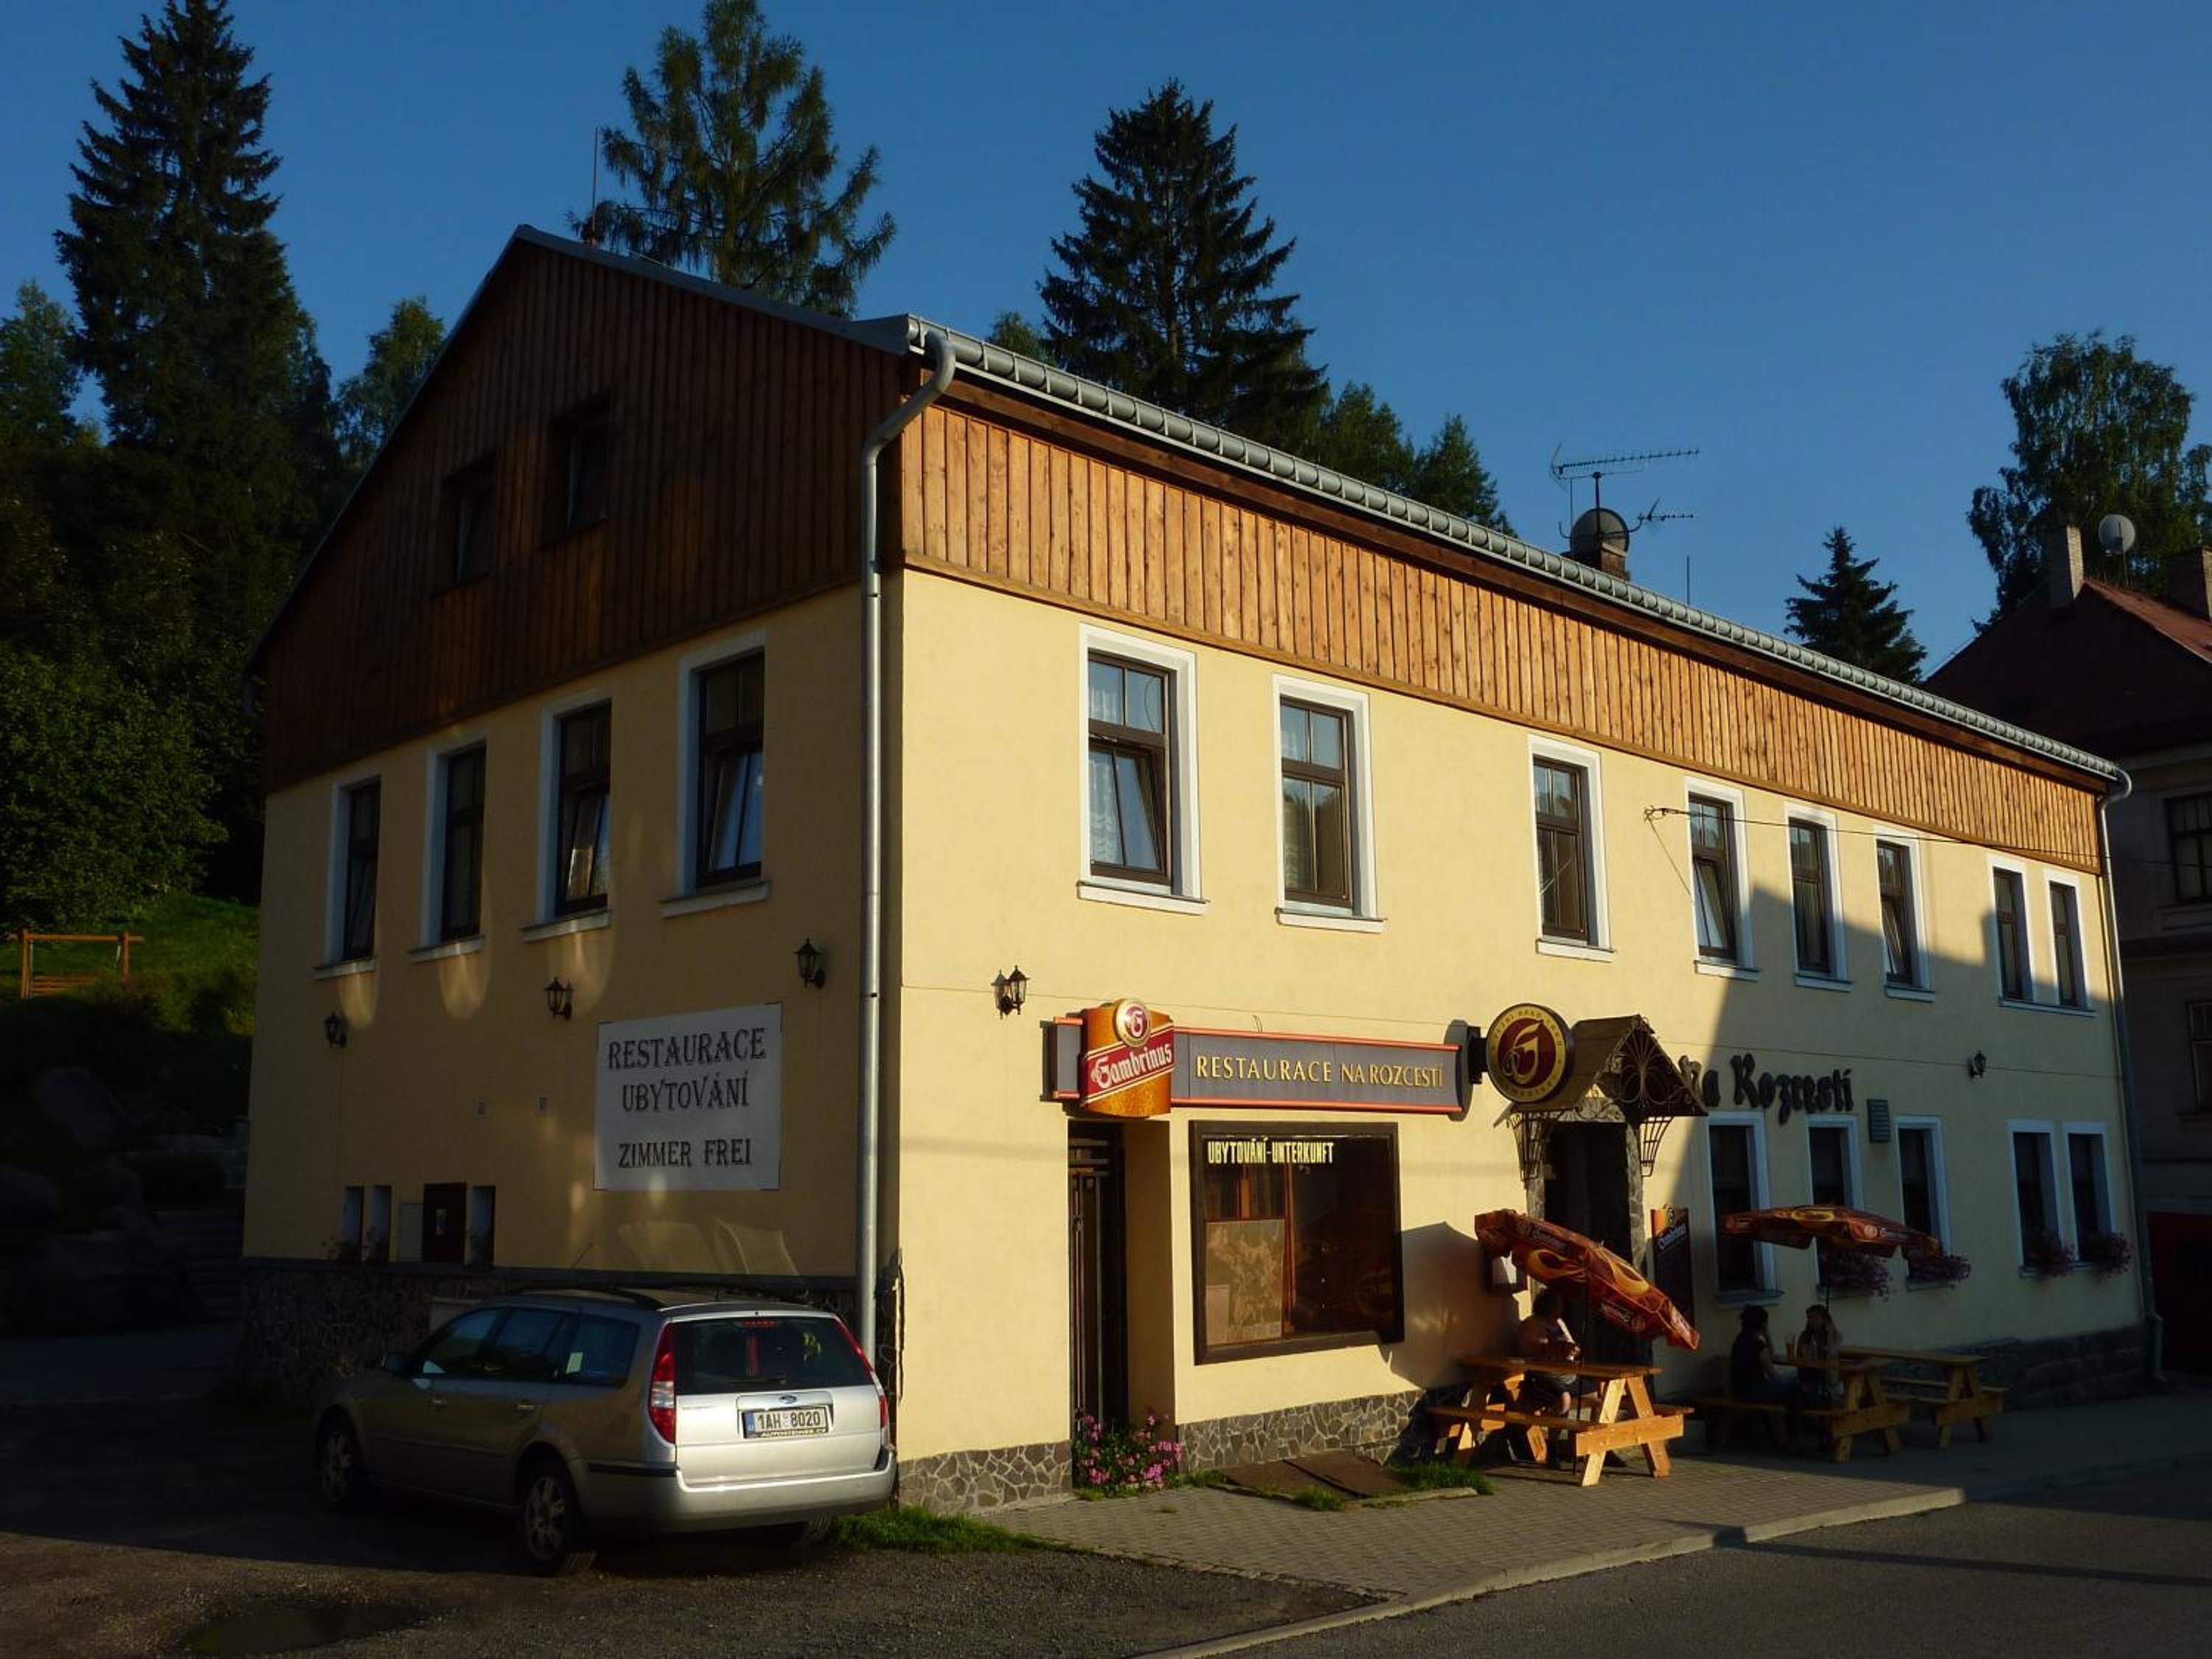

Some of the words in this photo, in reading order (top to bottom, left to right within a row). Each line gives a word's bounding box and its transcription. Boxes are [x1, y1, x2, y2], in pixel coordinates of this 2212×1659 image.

[608, 1027, 767, 1070] RESTAURACE
[1091, 1043, 1172, 1089] Gambrinus
[1195, 1054, 1332, 1082] RESTAURACE
[1340, 1062, 1366, 1084] NA
[1369, 1062, 1444, 1087] ROZCESTÍ
[618, 1141, 692, 1169] ZIMMER
[704, 1138, 753, 1166] FREI
[758, 1413, 782, 1430] 1AH
[790, 1411, 821, 1427] 8020
